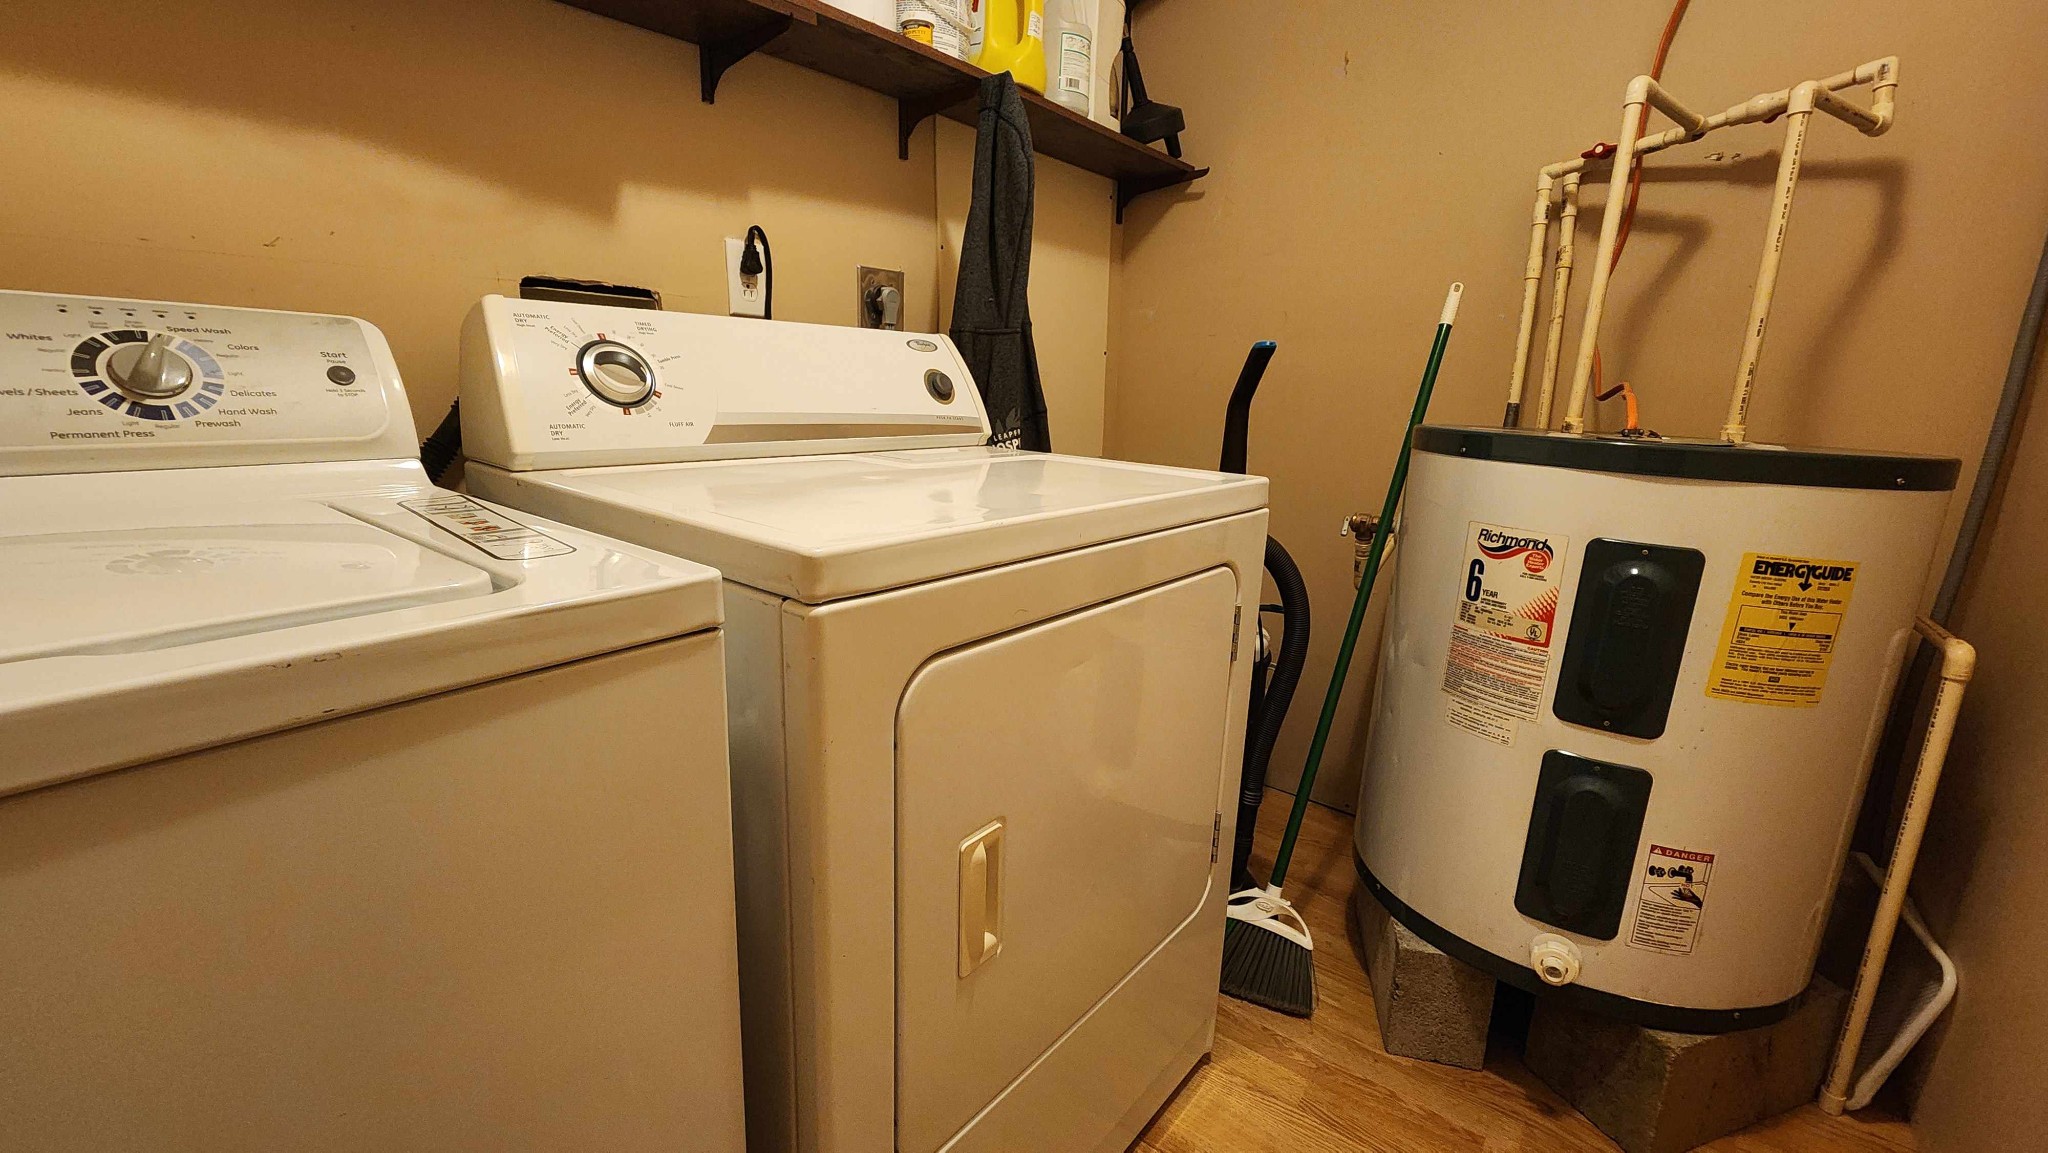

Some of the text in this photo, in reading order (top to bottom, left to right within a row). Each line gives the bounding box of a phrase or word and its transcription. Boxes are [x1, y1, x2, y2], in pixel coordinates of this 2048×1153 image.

[512, 312, 551, 320] AUTOMATIC
[166, 325, 232, 335] Speed Wash
[5, 332, 54, 342] Whites
[227, 343, 260, 352] Colors
[319, 350, 349, 359] Start
[34, 387, 79, 397] Sheets
[229, 389, 278, 398] Delicates
[66, 408, 104, 417] Jeans
[218, 408, 278, 416] Hand Wash
[195, 420, 242, 429] Prewash
[49, 430, 156, 440] Permanent Press
[1477, 528, 1549, 552] Richmond
[1465, 558, 1485, 602] 6
[1481, 588, 1499, 599] YEAR
[1741, 590, 1764, 599] Compare
[1665, 849, 1711, 862] DANGER
